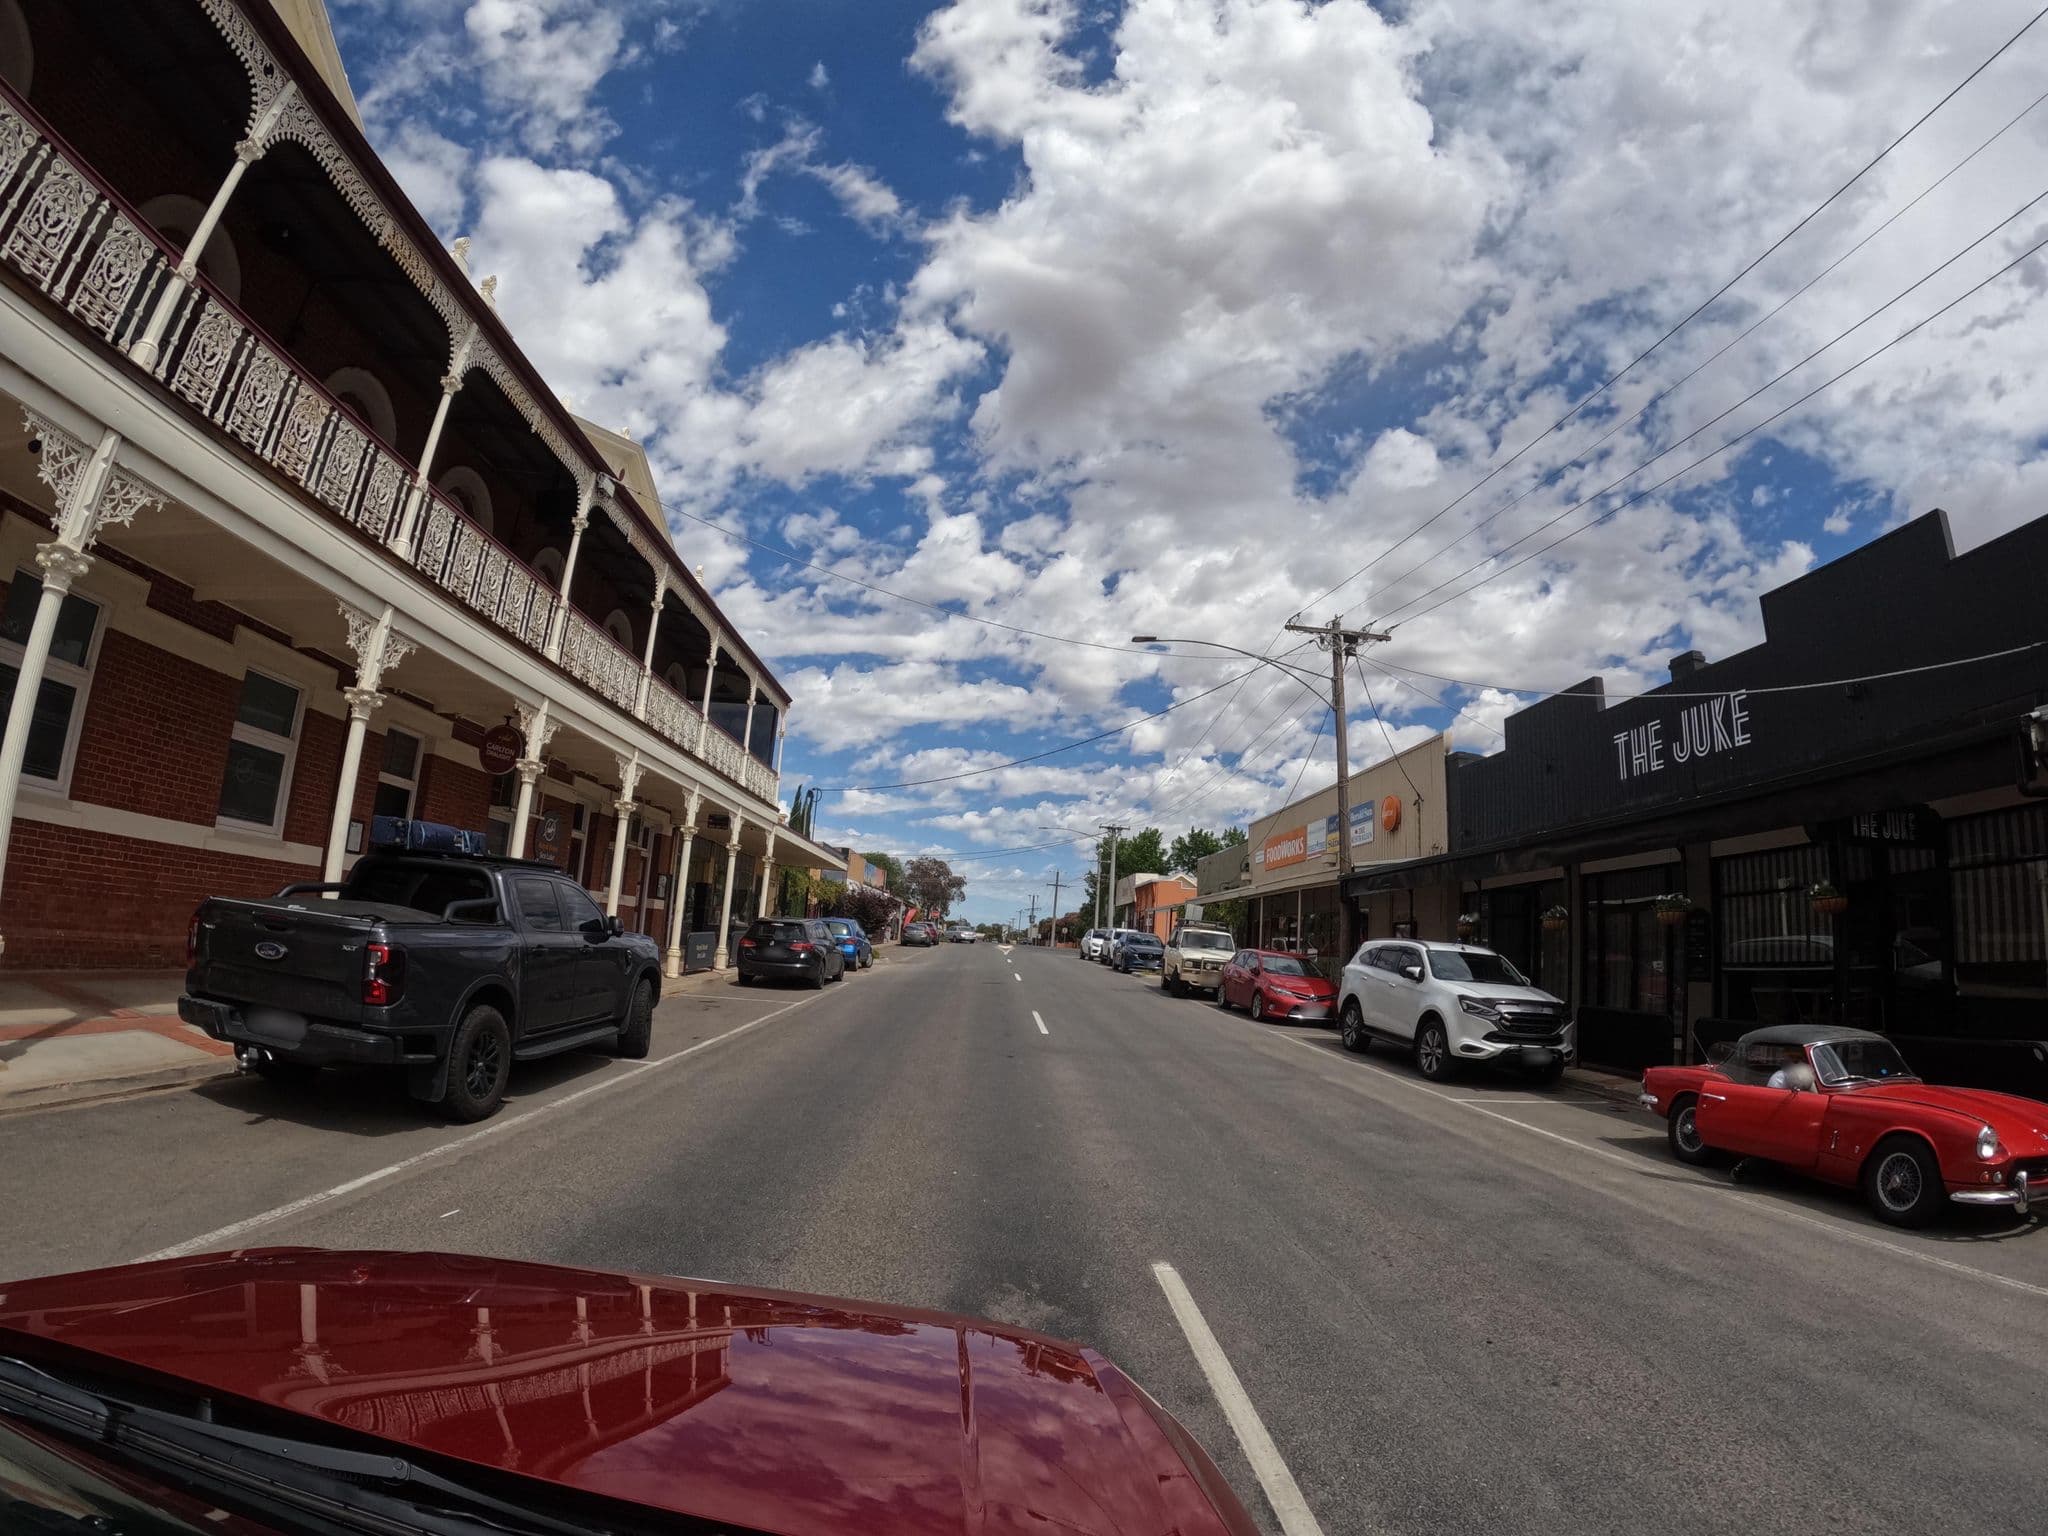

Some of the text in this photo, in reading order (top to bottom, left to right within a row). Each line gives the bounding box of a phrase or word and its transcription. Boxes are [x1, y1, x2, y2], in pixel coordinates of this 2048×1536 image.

[486, 742, 515, 756] CARLTON
[1613, 688, 1751, 780] THE JUKE
[1852, 809, 1916, 840] THE JUKE
